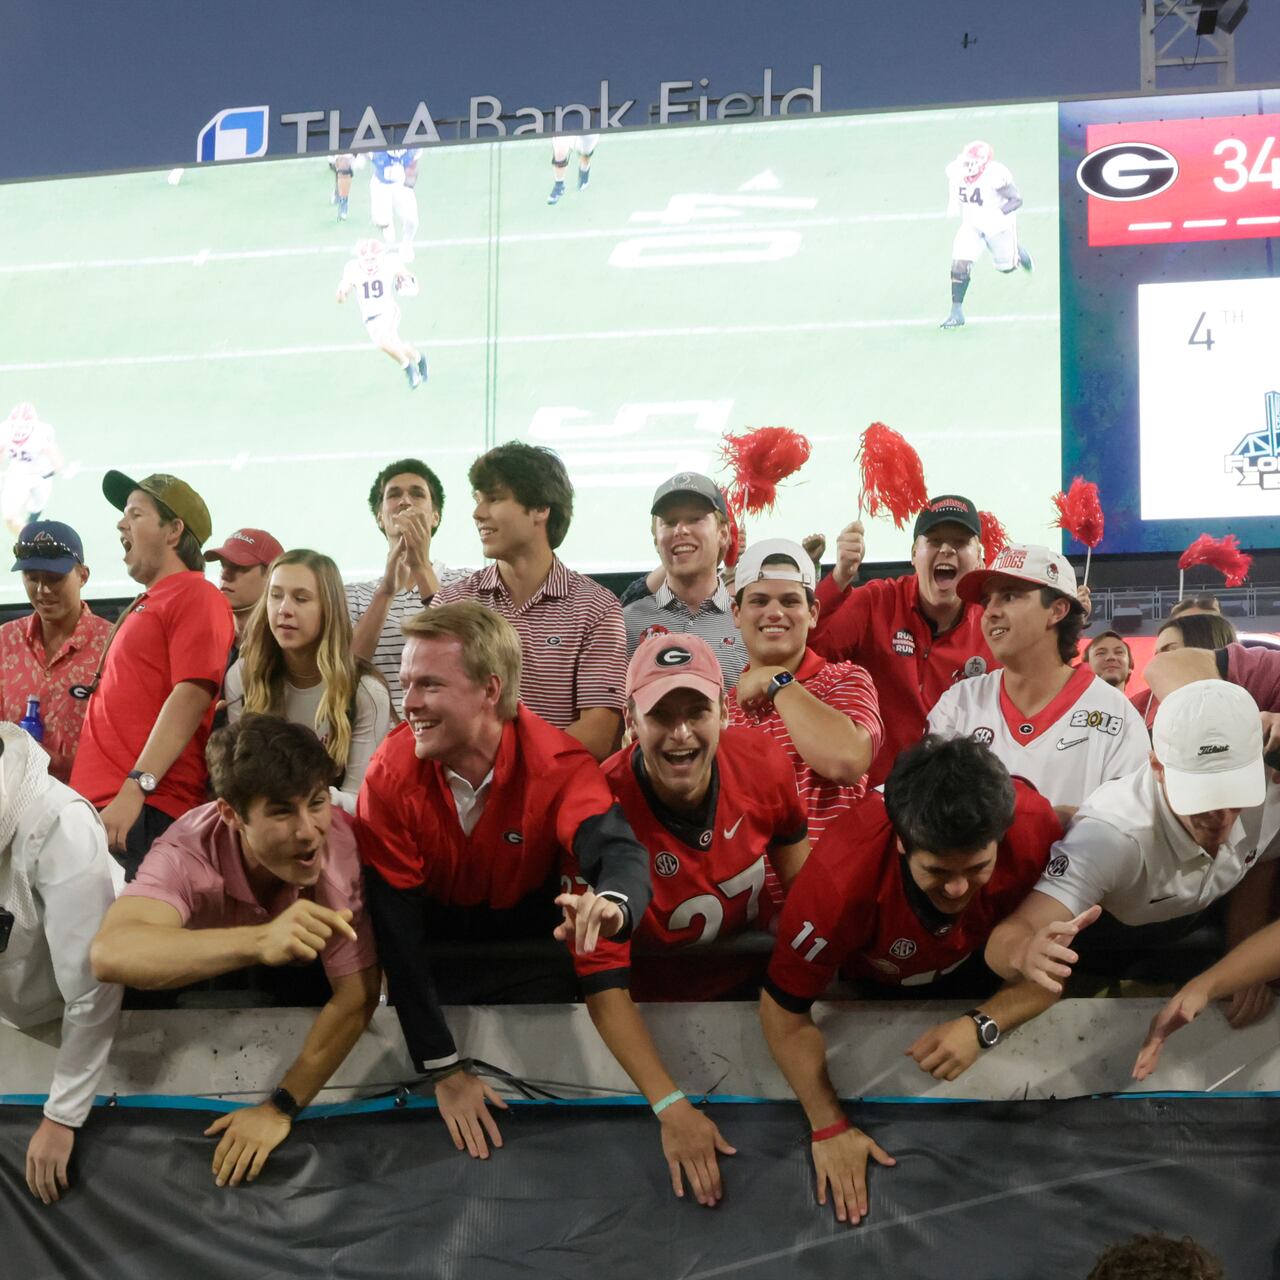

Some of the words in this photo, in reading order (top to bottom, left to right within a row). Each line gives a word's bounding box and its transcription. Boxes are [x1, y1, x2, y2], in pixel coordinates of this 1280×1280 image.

[280, 101, 441, 153] TIAA
[469, 79, 636, 141] Bank
[658, 64, 822, 122] Field
[362, 279, 384, 299] 19
[1070, 709, 1124, 737] 2018
[791, 920, 828, 962] 11
